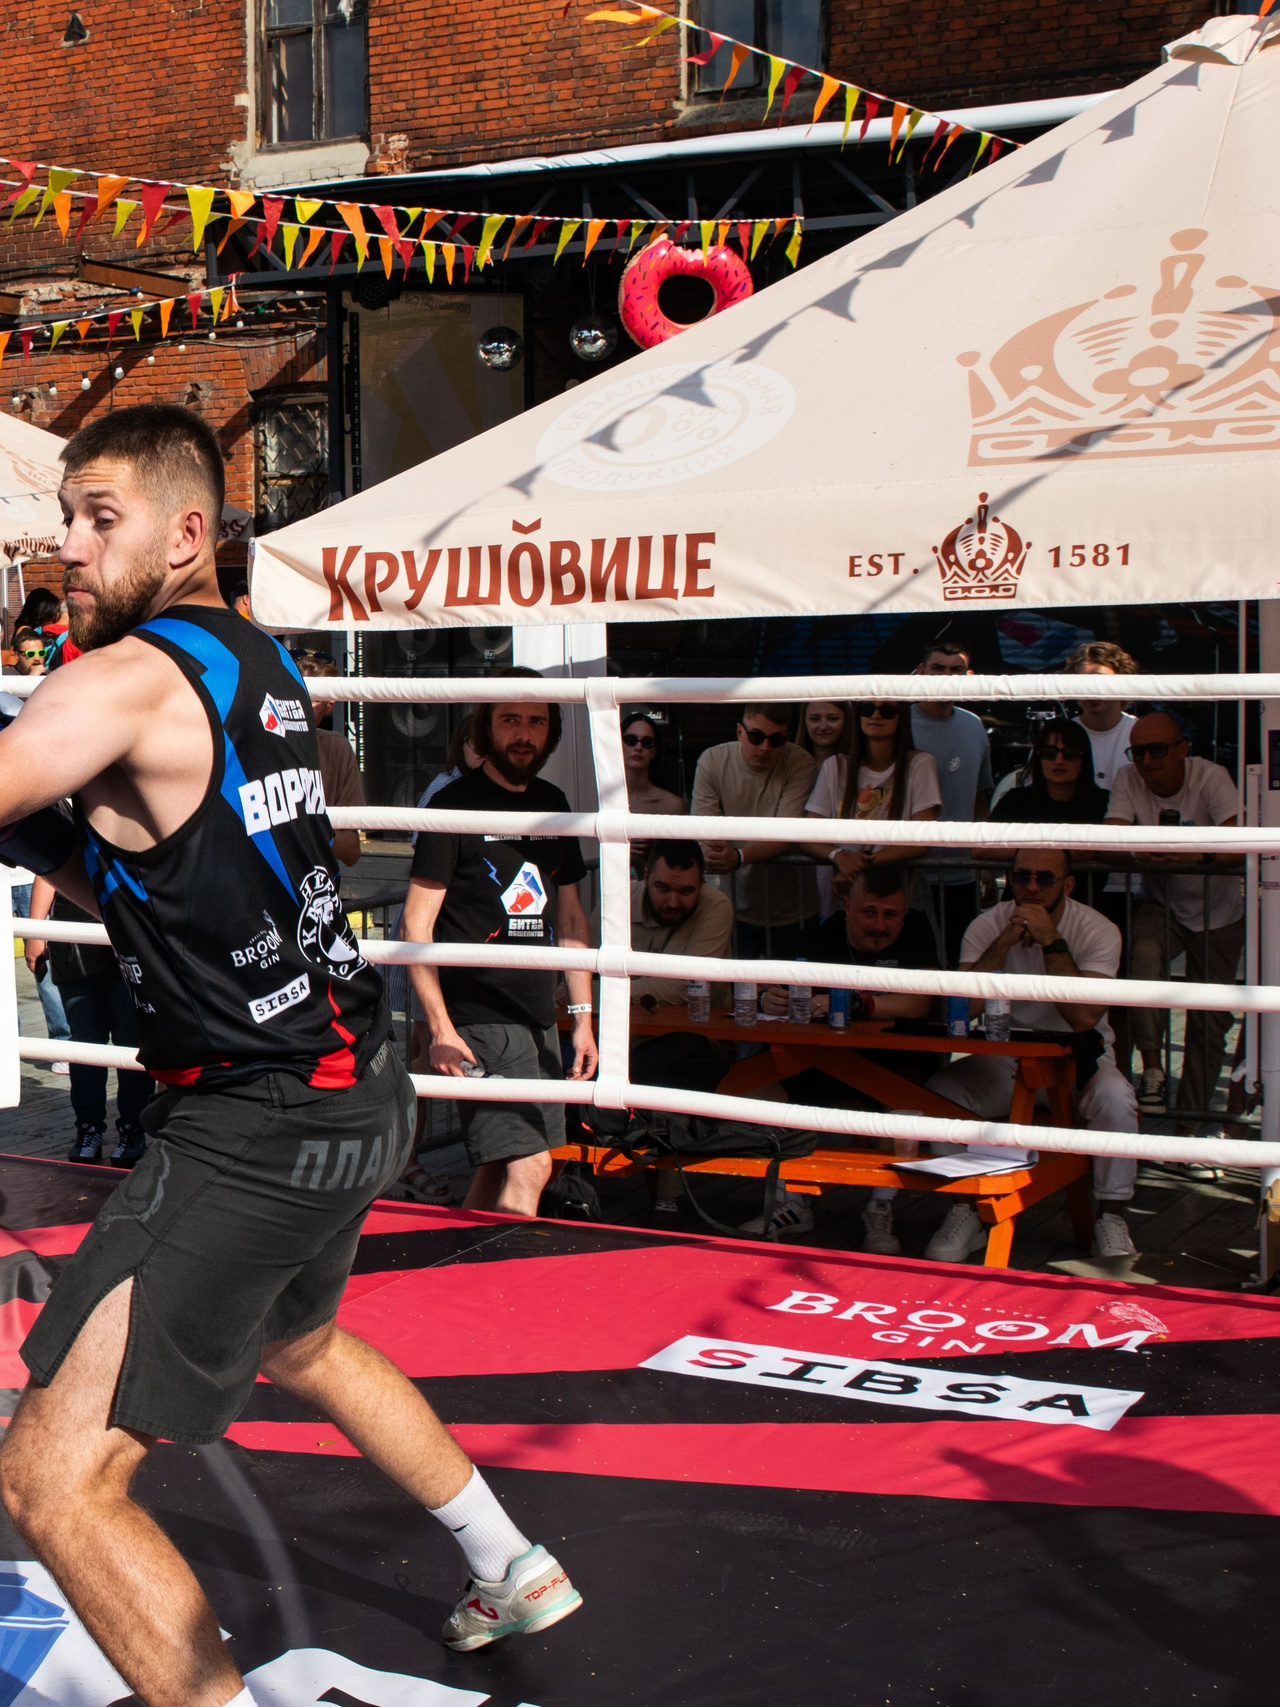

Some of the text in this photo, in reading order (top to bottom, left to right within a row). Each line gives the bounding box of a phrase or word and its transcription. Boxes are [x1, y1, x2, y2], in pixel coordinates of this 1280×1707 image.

[847, 541, 1131, 580] EST. 1581
[508, 918, 544, 931] БИТВА
[230, 926, 284, 968] BROOM
[259, 953, 281, 970] GIN
[255, 980, 308, 1017] SIBSA
[765, 1289, 1156, 1353] BROOM
[871, 1329, 986, 1354] GIN
[686, 1347, 1091, 1417] SIBSA
